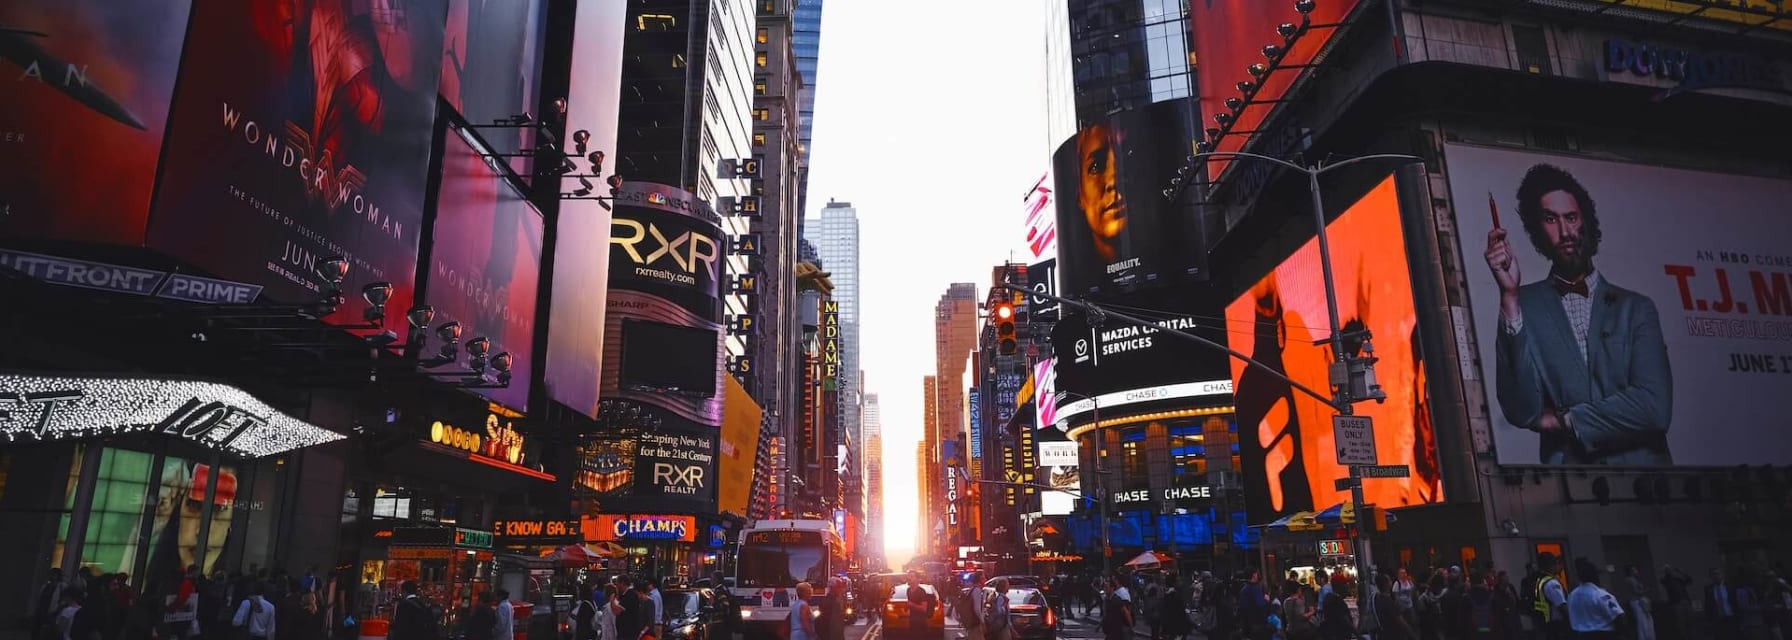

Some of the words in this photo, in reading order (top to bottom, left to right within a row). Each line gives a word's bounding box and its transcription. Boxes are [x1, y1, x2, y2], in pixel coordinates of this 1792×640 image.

[223, 102, 327, 190] WONDER
[338, 182, 402, 239] WOMAN
[229, 184, 246, 201] THE
[250, 196, 281, 221] FUTURE
[283, 216, 294, 227] OF
[297, 225, 326, 246] JUSTICE
[282, 240, 317, 273] JUN
[609, 218, 718, 282] RXR
[1696, 250, 1714, 262] AN
[1719, 251, 1750, 265] HBO
[740, 161, 757, 373] CHAMPS
[1106, 257, 1141, 274] EQUALITY.
[438, 260, 489, 308] WONDER
[635, 266, 695, 285] rxrrealty.com
[171, 277, 251, 304] PRIME
[825, 301, 838, 377] MADAME
[1102, 325, 1140, 343] MAZDA
[1102, 337, 1153, 356] SERVICES
[1728, 353, 1777, 374] JUNE
[1126, 391, 1157, 402] CHASE
[1203, 383, 1233, 393] CHAS
[1340, 420, 1365, 429] BUSES
[680, 435, 697, 447] New
[697, 438, 711, 449] York
[1344, 430, 1363, 439] ONLY
[640, 446, 656, 457] for
[656, 446, 671, 458] the
[672, 449, 688, 459] 21st
[688, 450, 713, 465] Century
[1023, 426, 1033, 468] VICTORY
[653, 463, 704, 488] RXR
[1370, 467, 1408, 477] Broadway
[663, 485, 697, 495] REALTY
[947, 466, 957, 525] REGAL
[1114, 490, 1149, 503] CHASE
[1164, 486, 1211, 500] CHASE
[506, 521, 543, 536] KNOW
[614, 519, 687, 537] CHAMPS
[1036, 550, 1059, 558] ubwy
[1320, 541, 1344, 554] SODA
